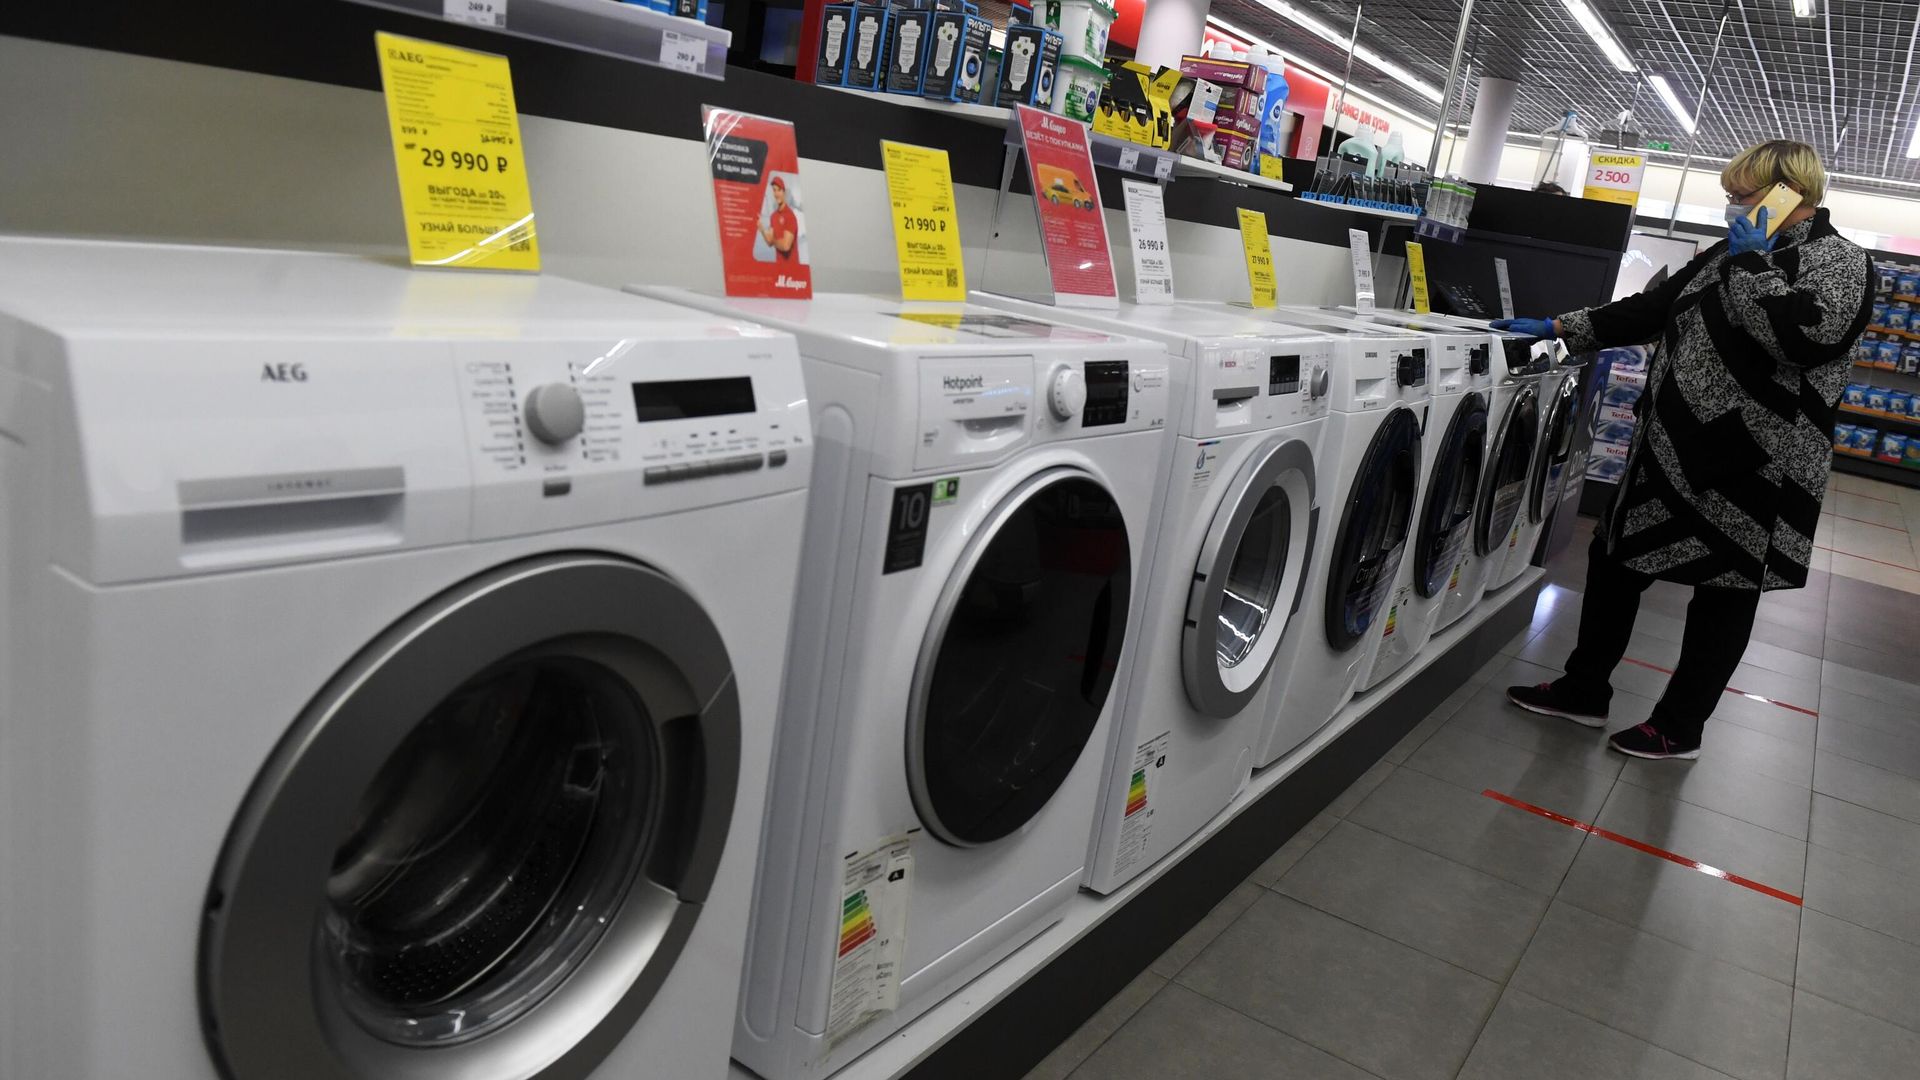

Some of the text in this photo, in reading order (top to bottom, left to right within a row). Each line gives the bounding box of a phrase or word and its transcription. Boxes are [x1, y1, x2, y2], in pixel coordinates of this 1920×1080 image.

[399, 51, 424, 64] AEG
[420, 147, 445, 168] 29
[451, 151, 489, 172] 990
[1598, 155, 1636, 166] СКИДКА
[427, 184, 477, 198] ВЫГОДА
[420, 219, 455, 233] УЗНАЙ
[903, 215, 915, 231] 21
[916, 217, 937, 233] 990
[1147, 239, 1159, 252] 990
[261, 362, 308, 382] AEG
[1615, 374, 1638, 384] Tefal
[943, 375, 983, 391] Hotpoint
[1611, 410, 1633, 421] Tefal
[1606, 446, 1628, 456] Tefal
[899, 492, 926, 530] 10
